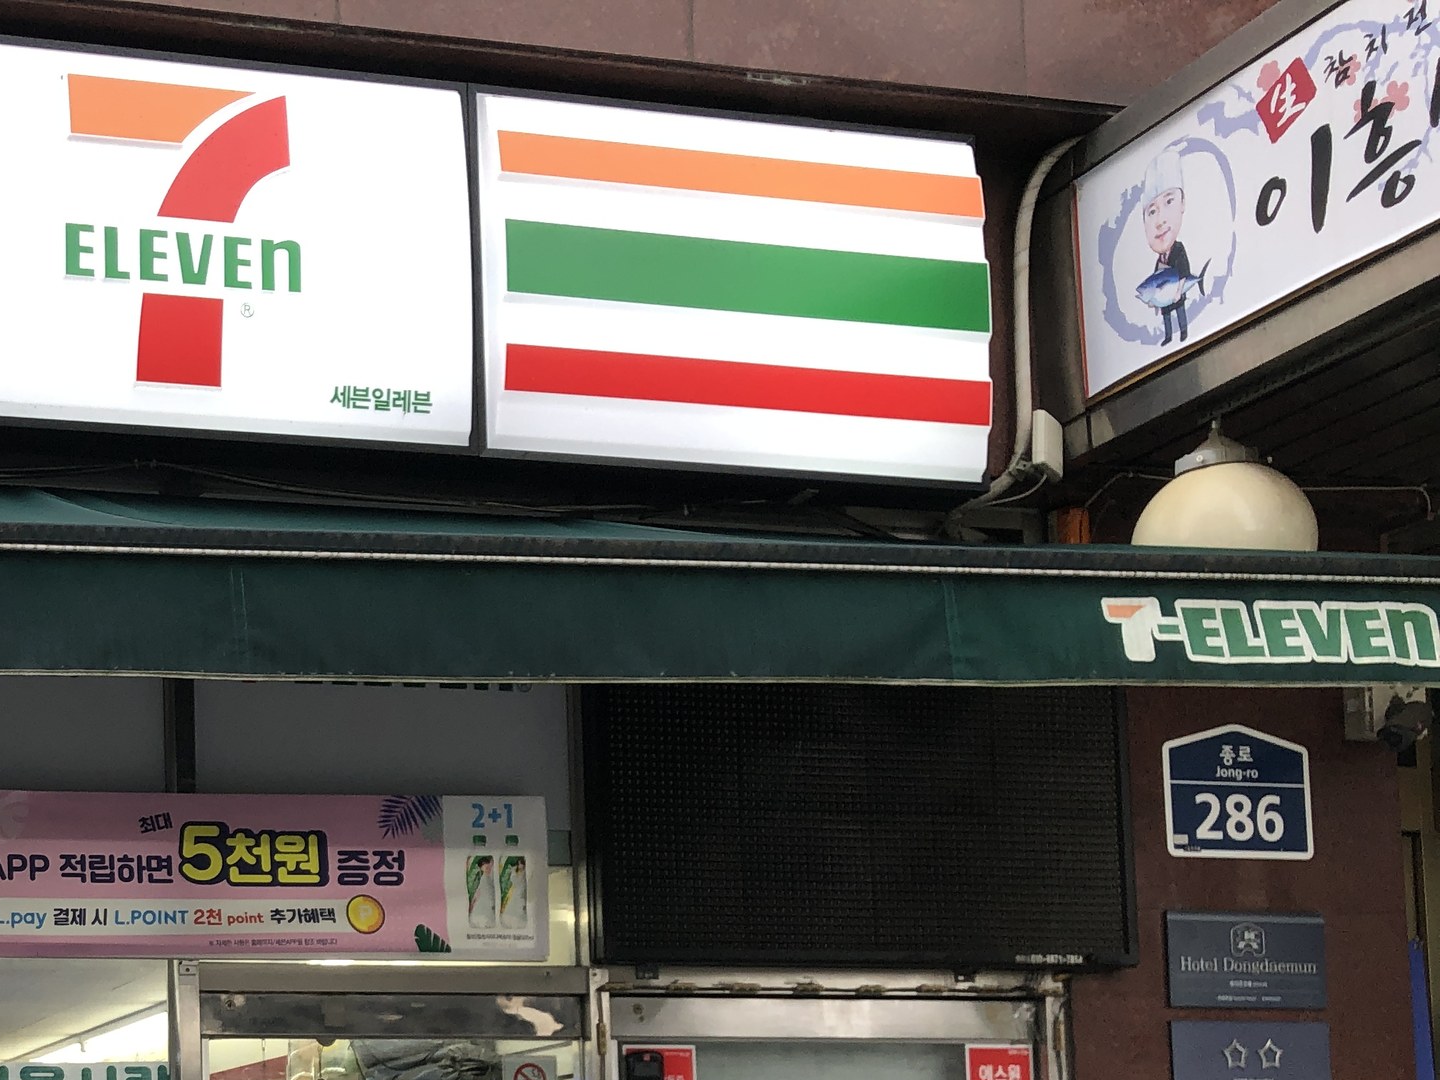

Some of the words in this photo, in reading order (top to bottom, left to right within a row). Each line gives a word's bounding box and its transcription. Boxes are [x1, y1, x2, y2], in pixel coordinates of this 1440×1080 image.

[1256, 57, 1440, 234] 이흥
[330, 385, 433, 414] 세븐일레븐
[1220, 745, 1254, 766] 종로
[1215, 765, 1259, 780] Jong-ro
[138, 812, 173, 835] 최대
[471, 803, 514, 829] 2+1
[1194, 792, 1285, 843] 286
[59, 853, 174, 885] 적립하면
[180, 822, 327, 887] 5천원
[336, 850, 406, 887] 증정
[53, 907, 88, 927] 결제
[92, 909, 108, 927] 시
[114, 908, 189, 927] L.POINT
[193, 908, 223, 927] 2천
[227, 911, 265, 926] point
[269, 906, 337, 927] 추가혜택
[1180, 955, 1218, 974] Hotel
[1222, 956, 1318, 975] Dongdaemun
